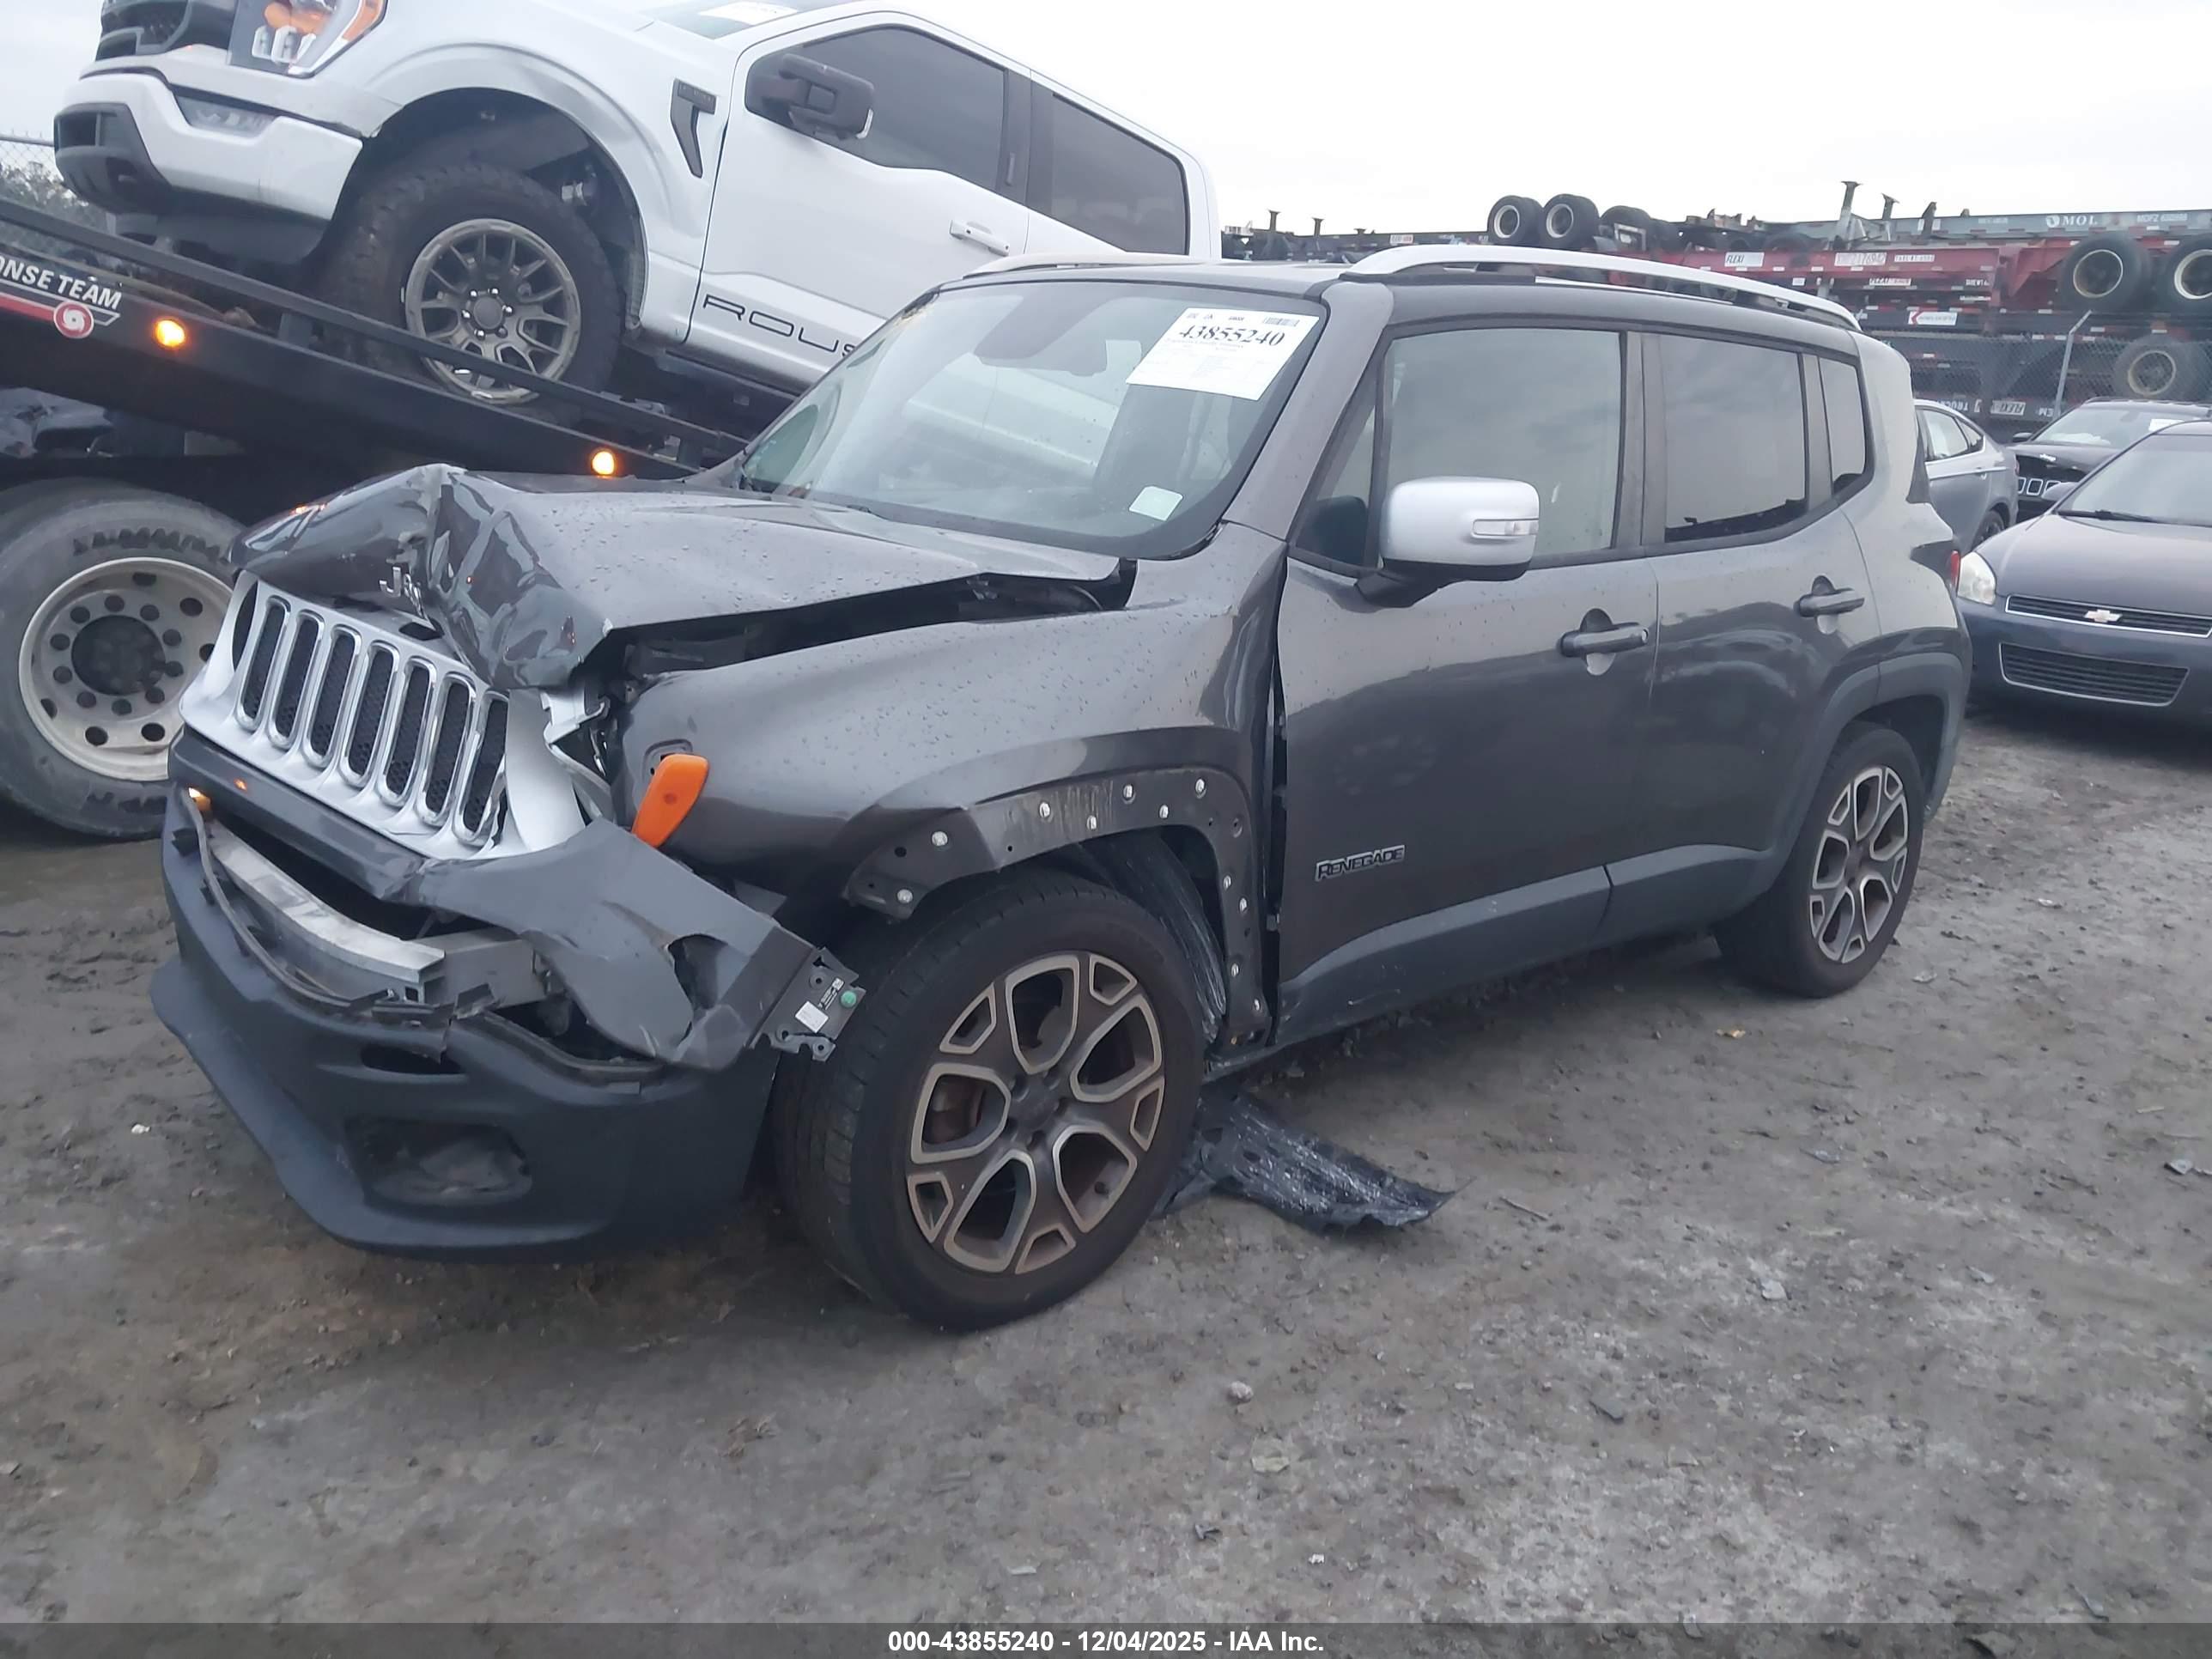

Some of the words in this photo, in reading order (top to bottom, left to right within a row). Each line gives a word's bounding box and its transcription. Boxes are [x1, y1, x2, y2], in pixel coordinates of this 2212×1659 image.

[2062, 215, 2099, 226] MOL
[58, 274, 122, 309] TEAM
[1179, 324, 1286, 346] 43855240
[1315, 845, 1406, 882] RENEGADE
